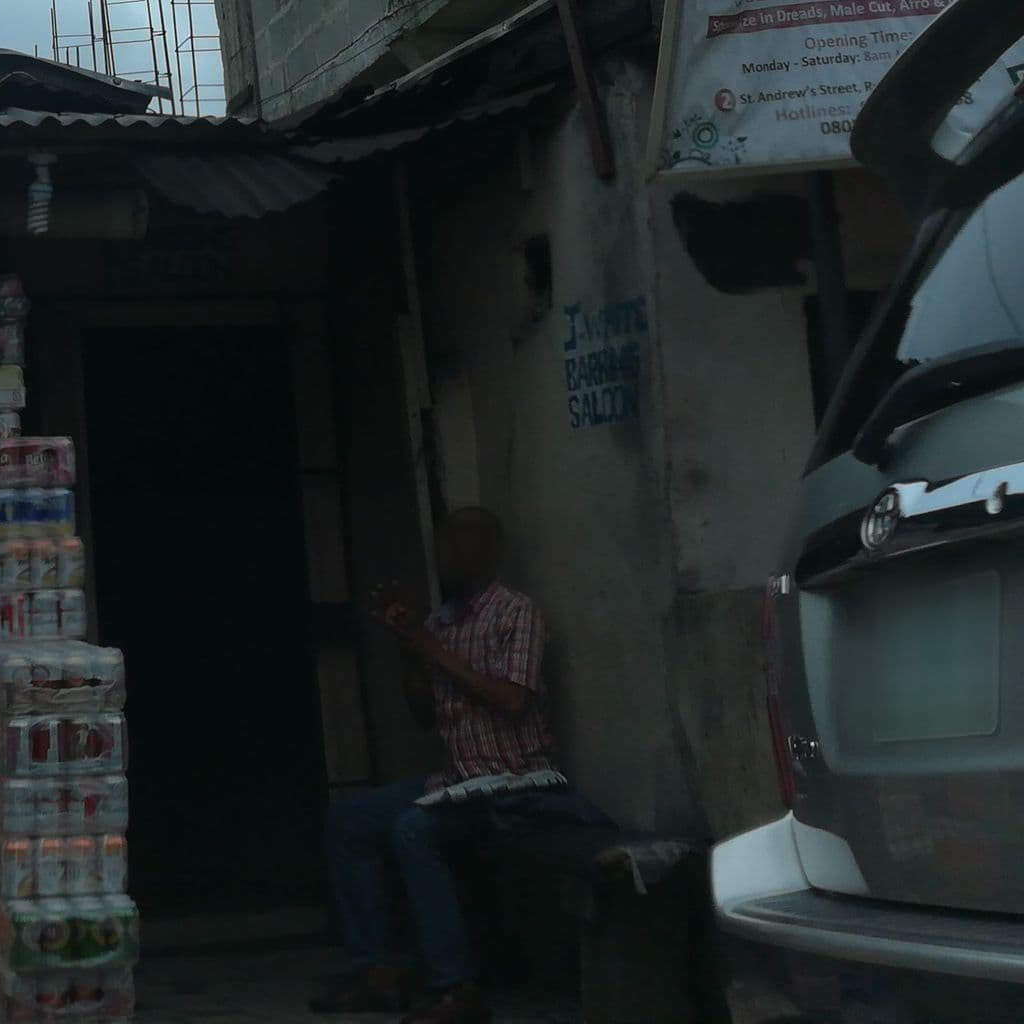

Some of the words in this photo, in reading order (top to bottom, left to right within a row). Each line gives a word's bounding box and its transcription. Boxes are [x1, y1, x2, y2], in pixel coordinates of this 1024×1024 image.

[760, 11, 774, 25] in
[776, 6, 827, 23] Dreads,
[830, 2, 864, 17] Male
[868, 0, 897, 14] Cut,
[804, 32, 868, 49] Opening
[741, 60, 791, 74] Monday
[801, 52, 861, 68] Saturday:
[863, 50, 891, 62] 8am
[739, 93, 756, 105] St.
[758, 86, 817, 104] Andrew's
[818, 82, 862, 96] Street,
[775, 103, 850, 121] Hotlines:
